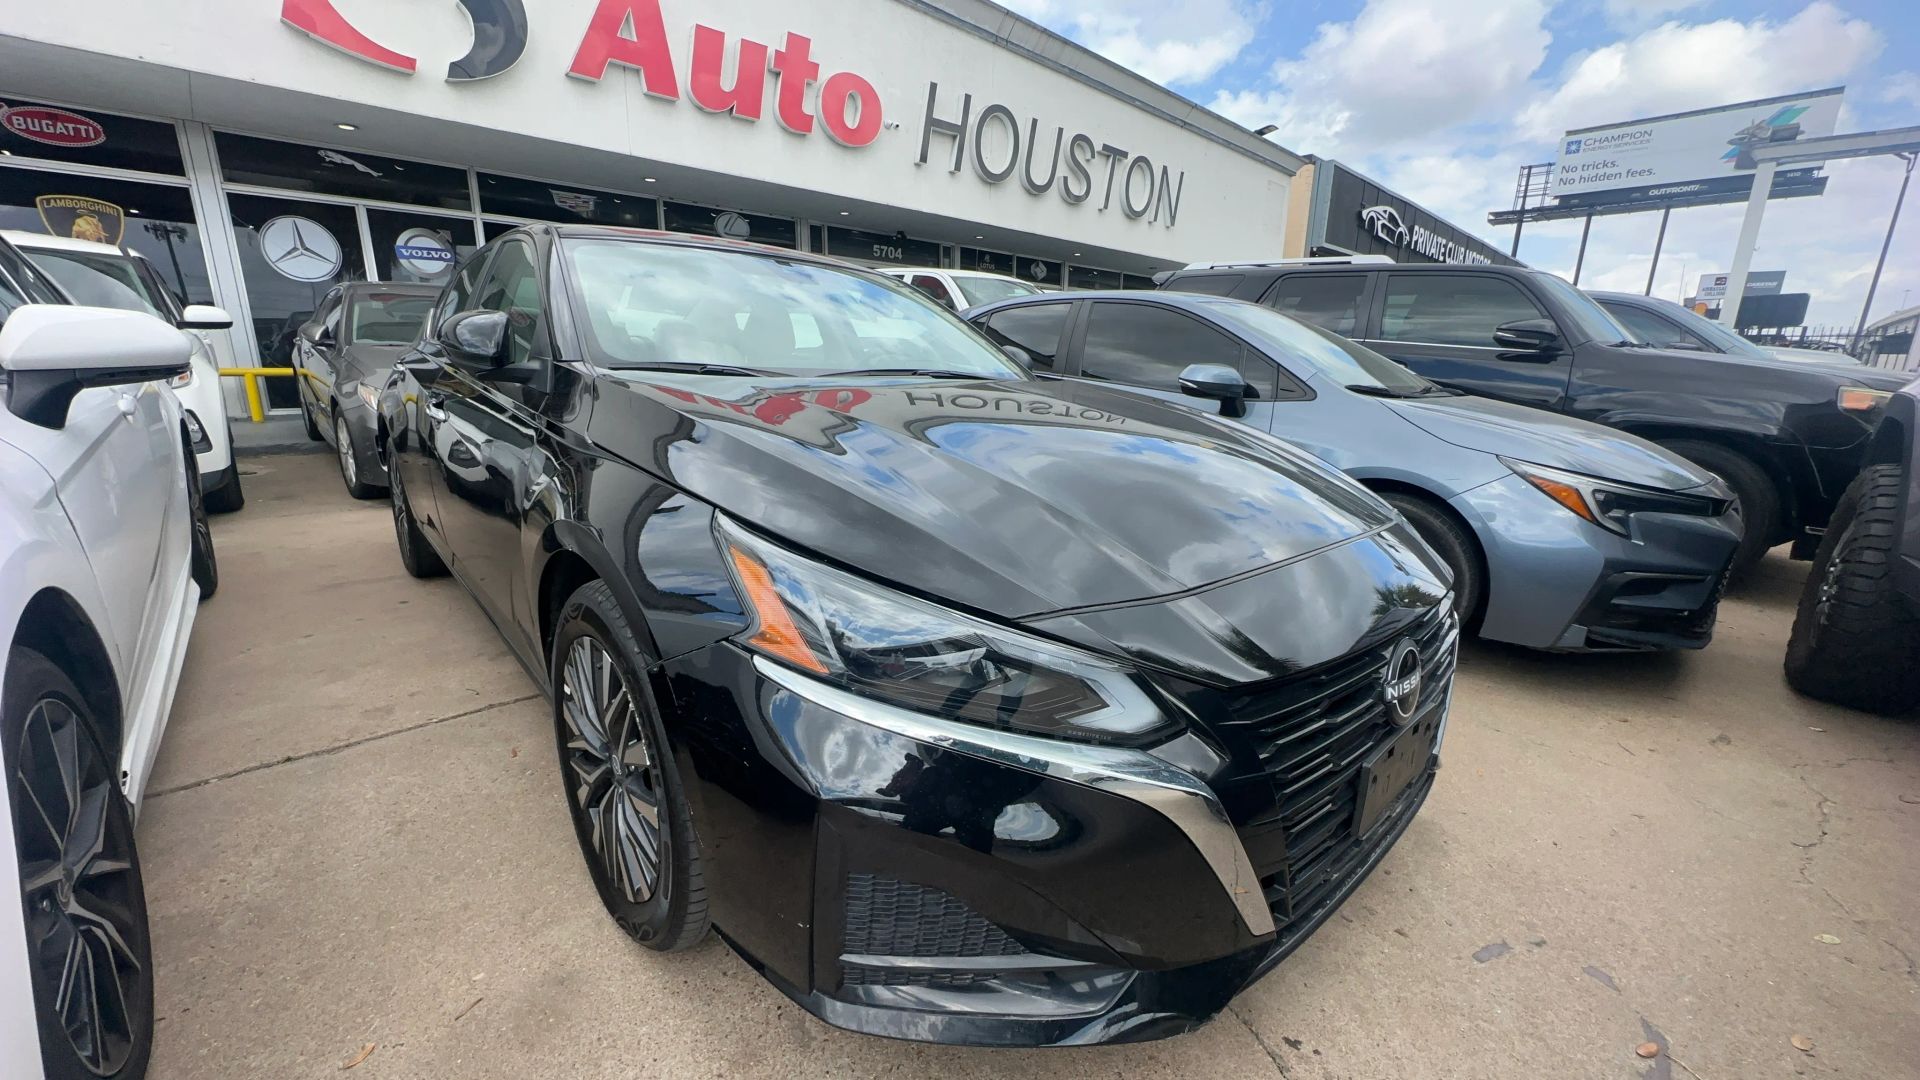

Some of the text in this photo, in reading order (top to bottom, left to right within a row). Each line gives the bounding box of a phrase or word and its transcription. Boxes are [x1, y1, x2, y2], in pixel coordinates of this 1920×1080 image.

[566, 0, 1185, 228] Auto HOUSTON
[11, 115, 96, 139] BUGATTI
[1584, 130, 1653, 147] CHAMPION
[1560, 160, 1620, 175] No tricks.
[1558, 168, 1656, 187] No hidden fees.
[43, 199, 119, 217] LAMBORGHINI
[400, 248, 452, 259] VOLVO
[872, 244, 903, 260] 5704
[1410, 224, 1447, 262] PRIVATE
[1445, 241, 1465, 265] CLUB
